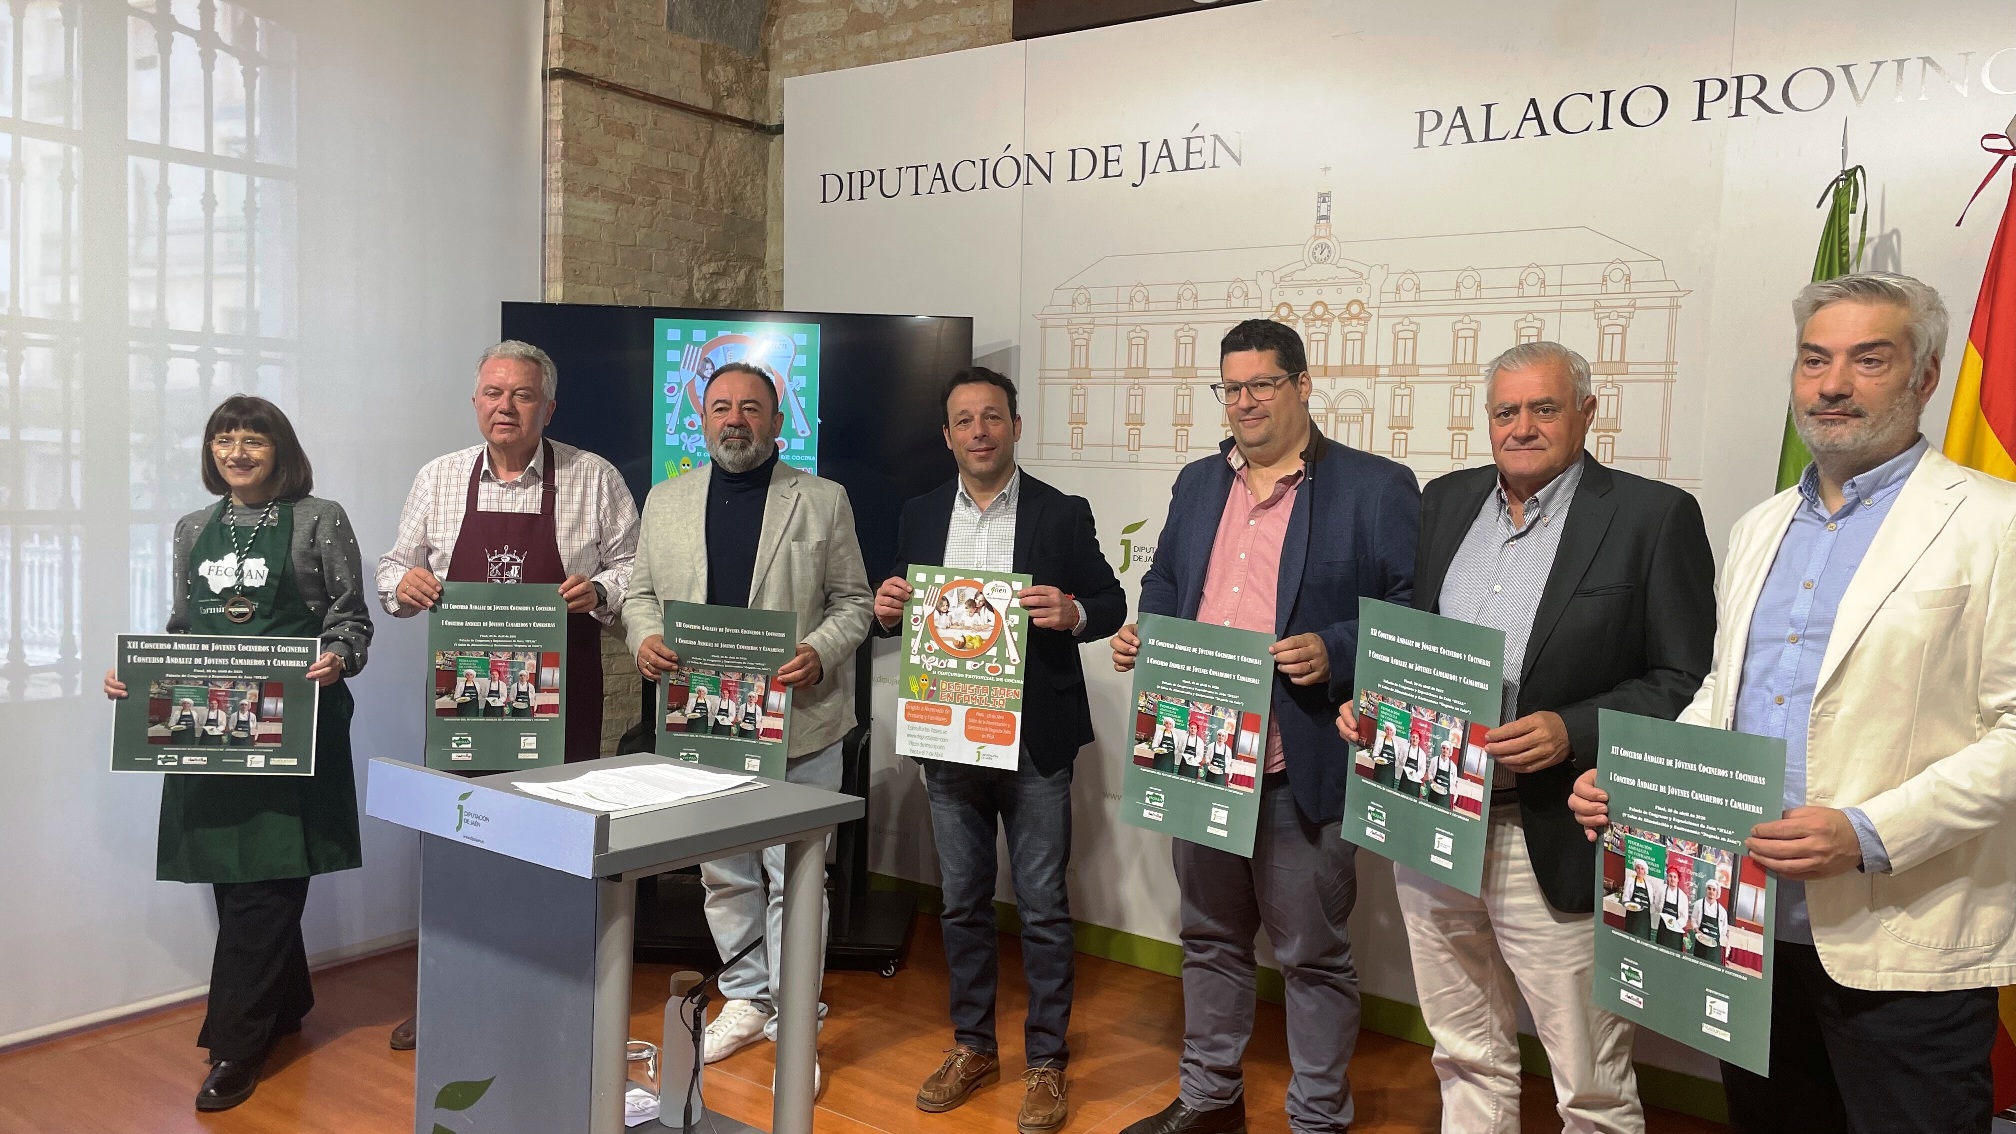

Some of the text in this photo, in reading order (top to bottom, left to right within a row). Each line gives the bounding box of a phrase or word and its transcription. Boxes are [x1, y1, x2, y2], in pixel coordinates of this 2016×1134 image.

[1413, 84, 1670, 150] PALACIO
[820, 122, 1245, 204] DIPUTACIÓN DE JAÉN
[940, 680, 989, 696] DEGUSTA
[940, 691, 1006, 708] EN FAMILIA
